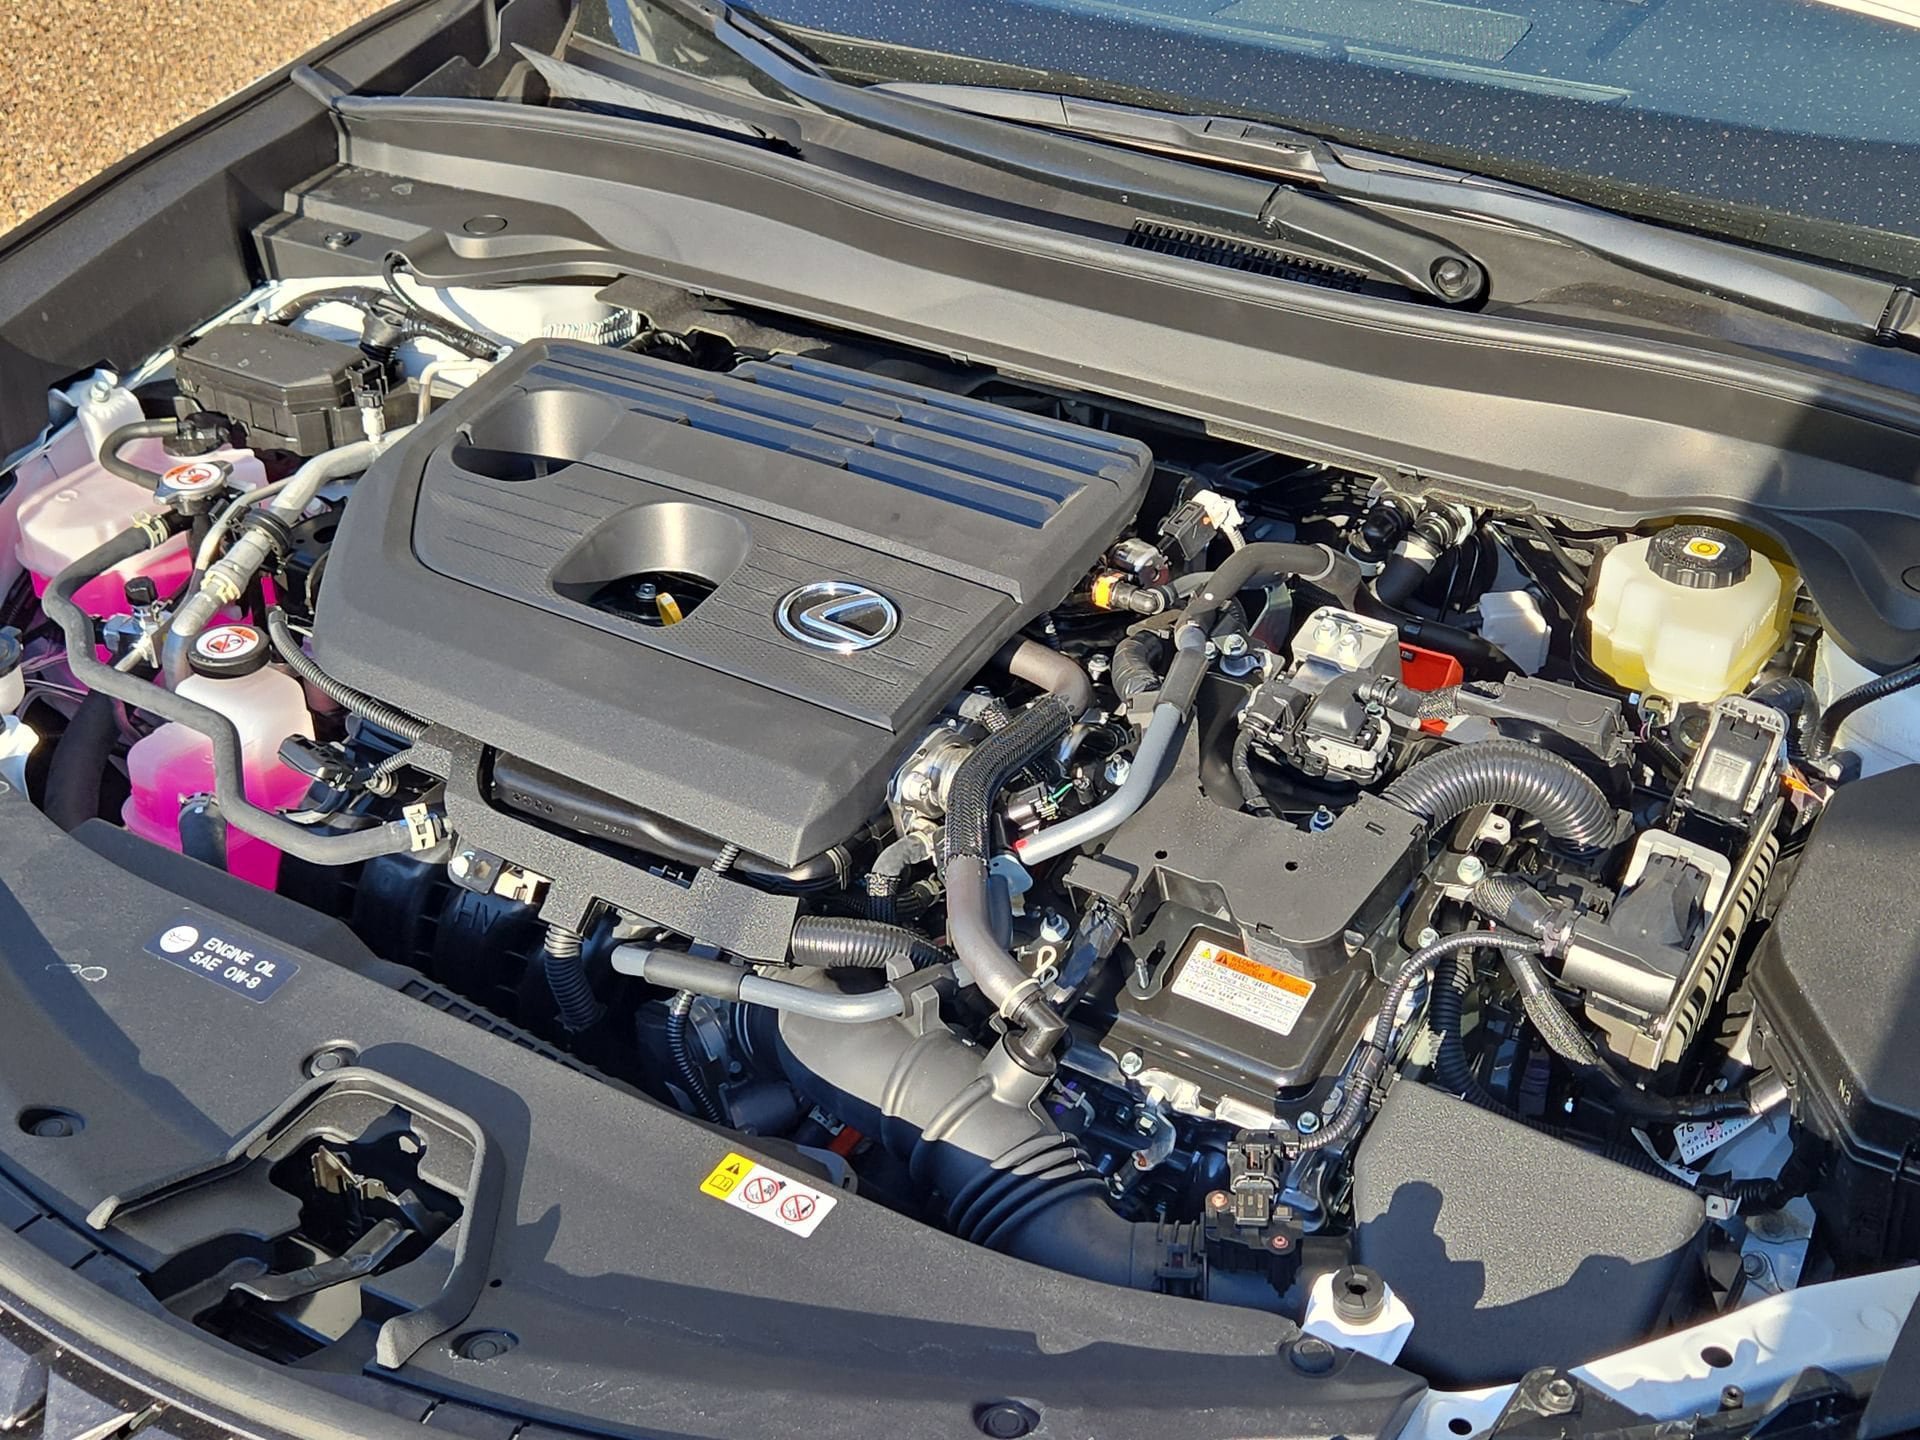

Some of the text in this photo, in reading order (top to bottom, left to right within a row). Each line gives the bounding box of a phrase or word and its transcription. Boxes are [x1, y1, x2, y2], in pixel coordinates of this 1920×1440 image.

[453, 895, 502, 935] HV
[189, 951, 261, 989] SAE 0W-8
[203, 937, 278, 978] ENGINE OIL
